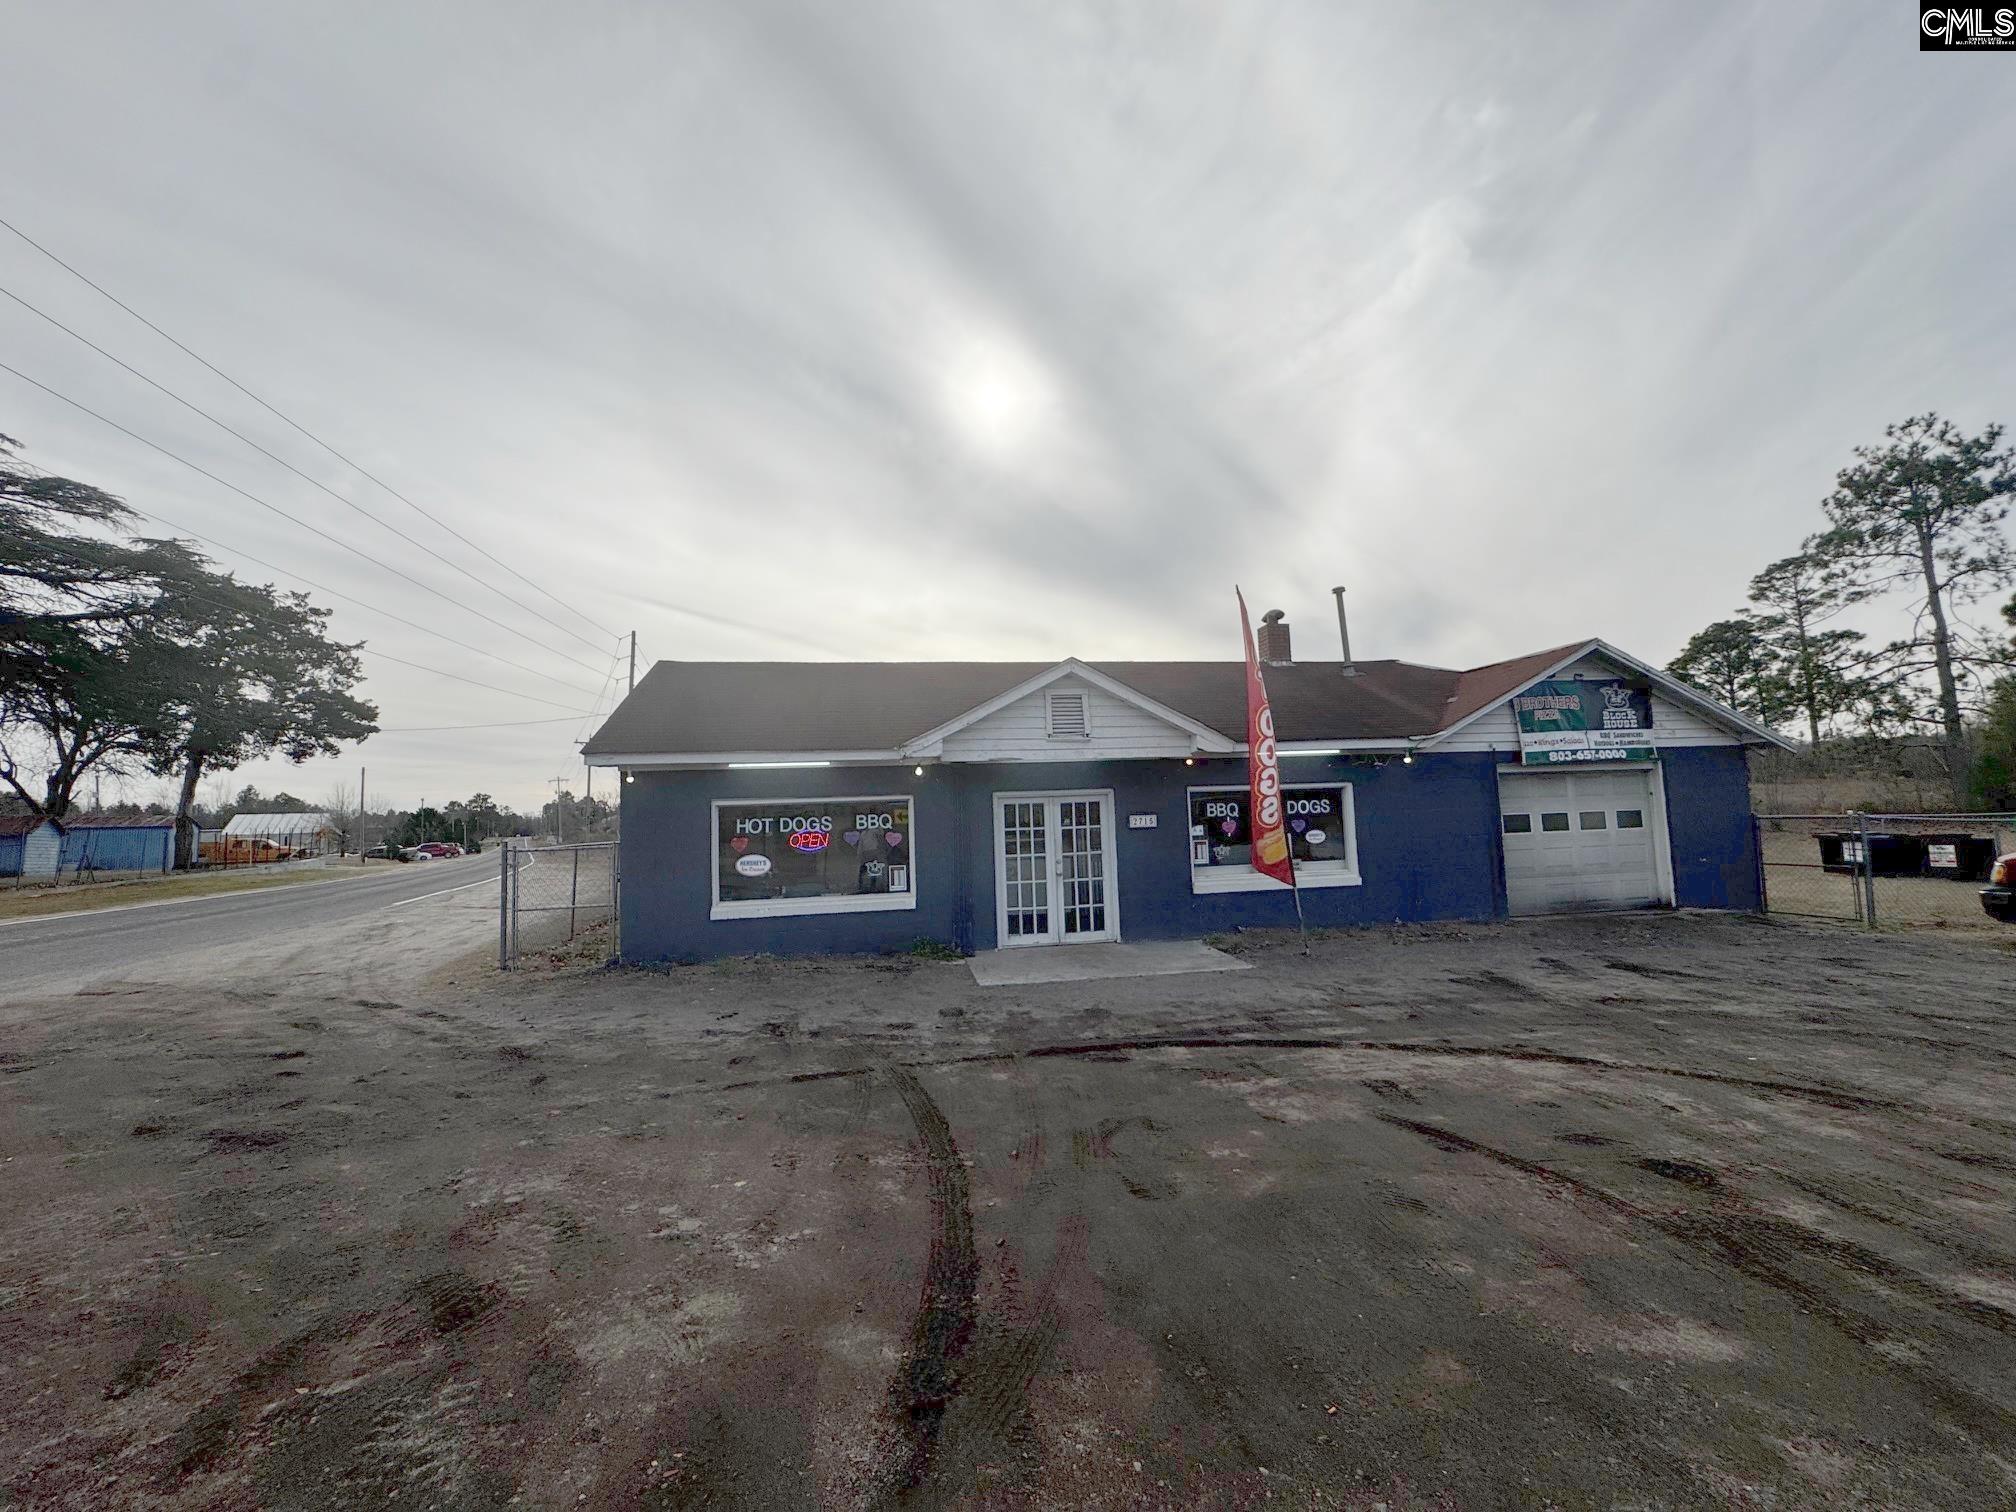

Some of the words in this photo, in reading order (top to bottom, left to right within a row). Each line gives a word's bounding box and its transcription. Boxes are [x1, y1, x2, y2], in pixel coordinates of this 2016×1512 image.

[1521, 695, 1580, 711] BROTHERS
[1602, 710, 1637, 719] BLOCK
[1603, 720, 1638, 728] HOUSE
[1549, 749, 1627, 762] 803-657-0000
[1206, 802, 1239, 818] BBQ
[1286, 800, 1330, 815] DOGS
[736, 818, 773, 834] HOT
[780, 816, 832, 833] DOGS
[856, 814, 893, 830] BBQ
[789, 833, 830, 848] OPEN
